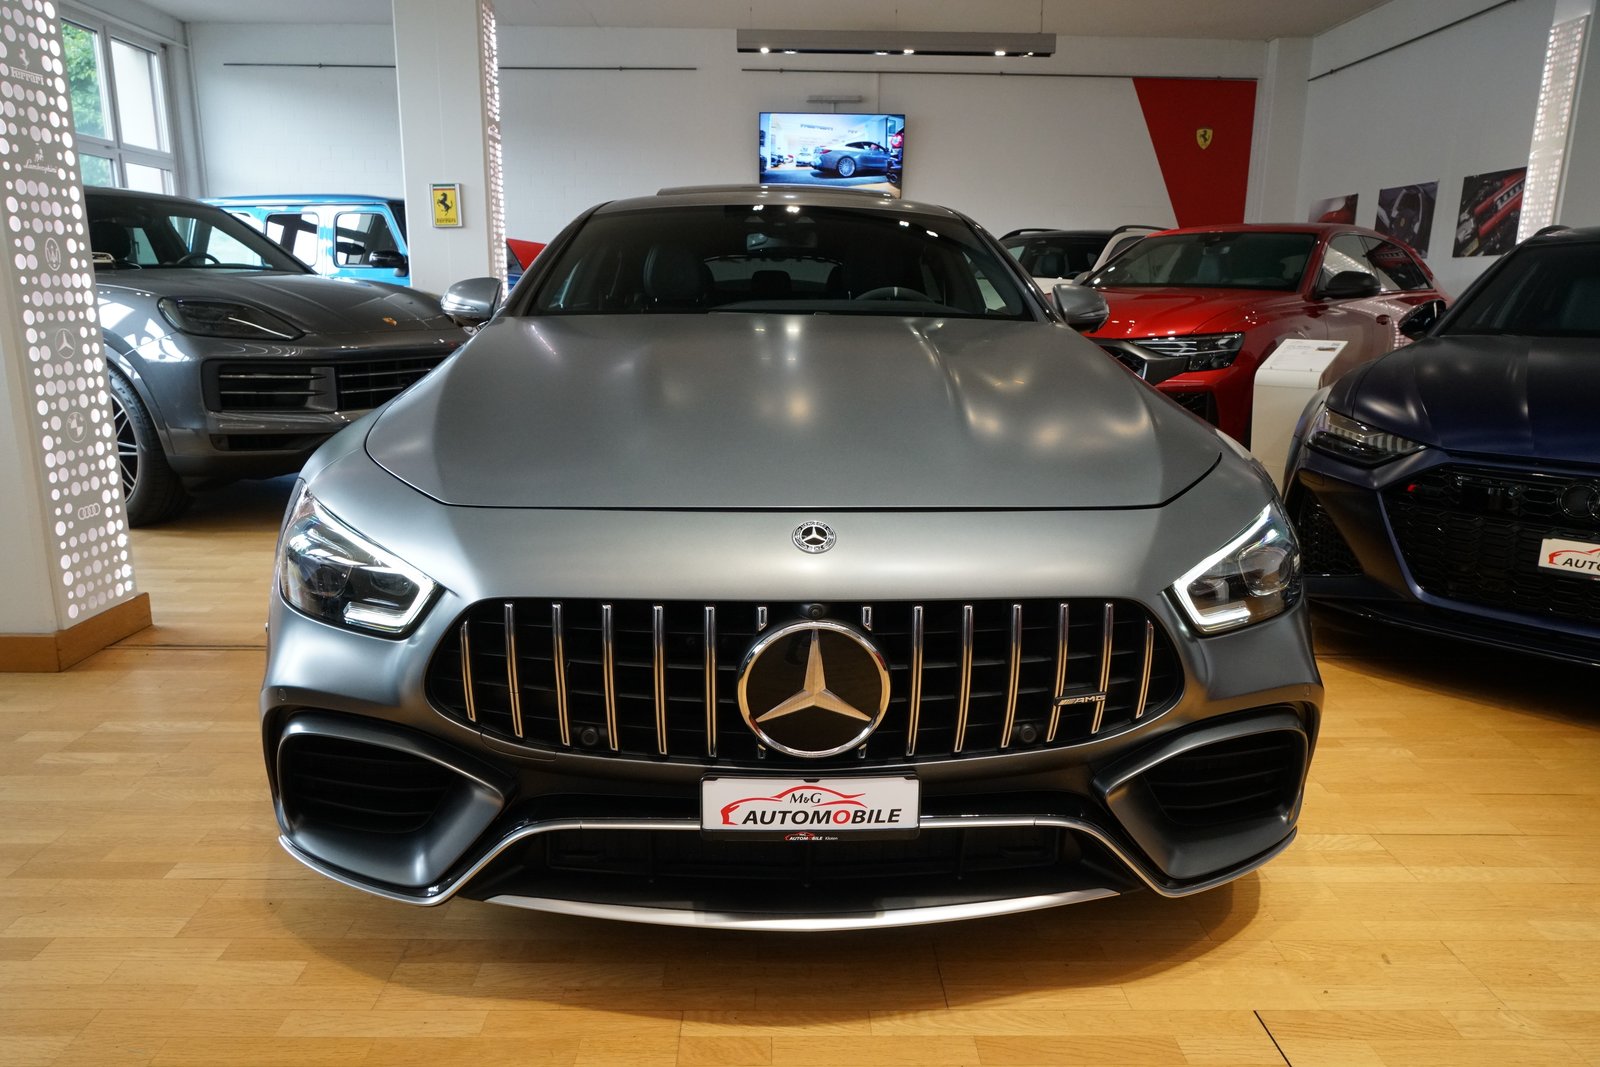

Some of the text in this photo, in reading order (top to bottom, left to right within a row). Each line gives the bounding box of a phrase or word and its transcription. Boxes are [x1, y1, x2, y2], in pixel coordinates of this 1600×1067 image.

[1073, 694, 1106, 703] AMG
[789, 792, 822, 804] M&G
[742, 808, 902, 825] AUTOMOBILE
